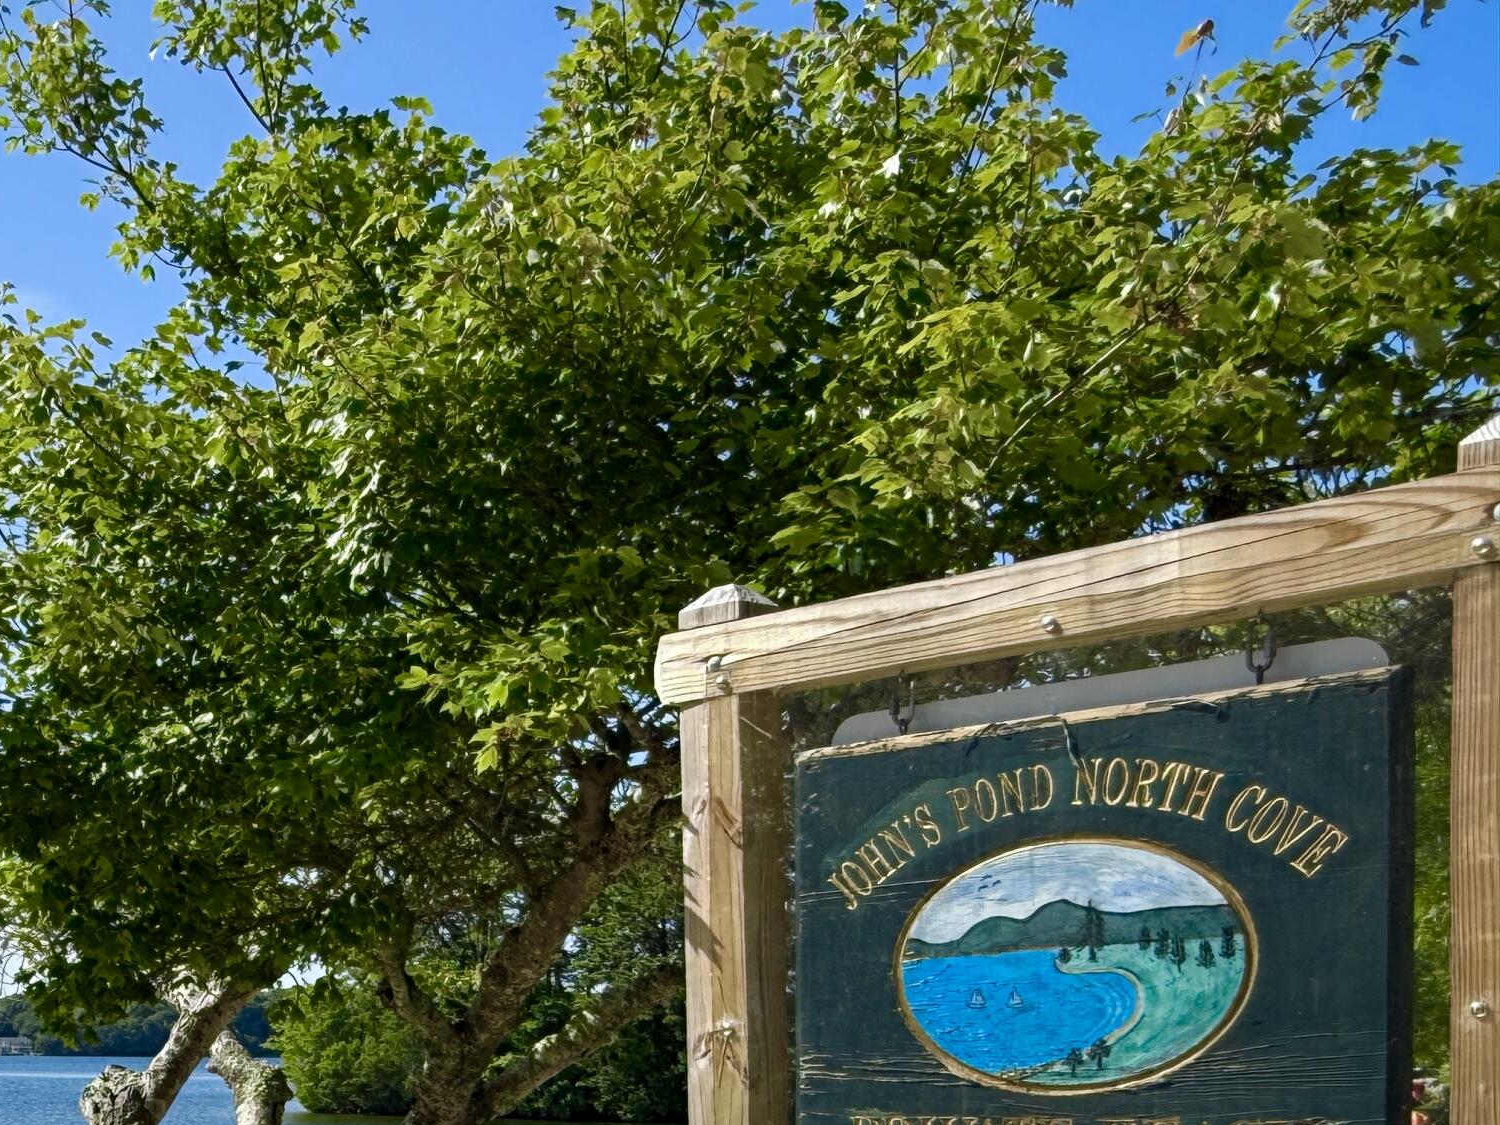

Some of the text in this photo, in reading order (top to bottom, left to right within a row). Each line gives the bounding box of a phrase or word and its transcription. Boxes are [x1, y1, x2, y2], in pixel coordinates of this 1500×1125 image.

[827, 757, 1350, 911] JOHN'S POND NORTH COVE
